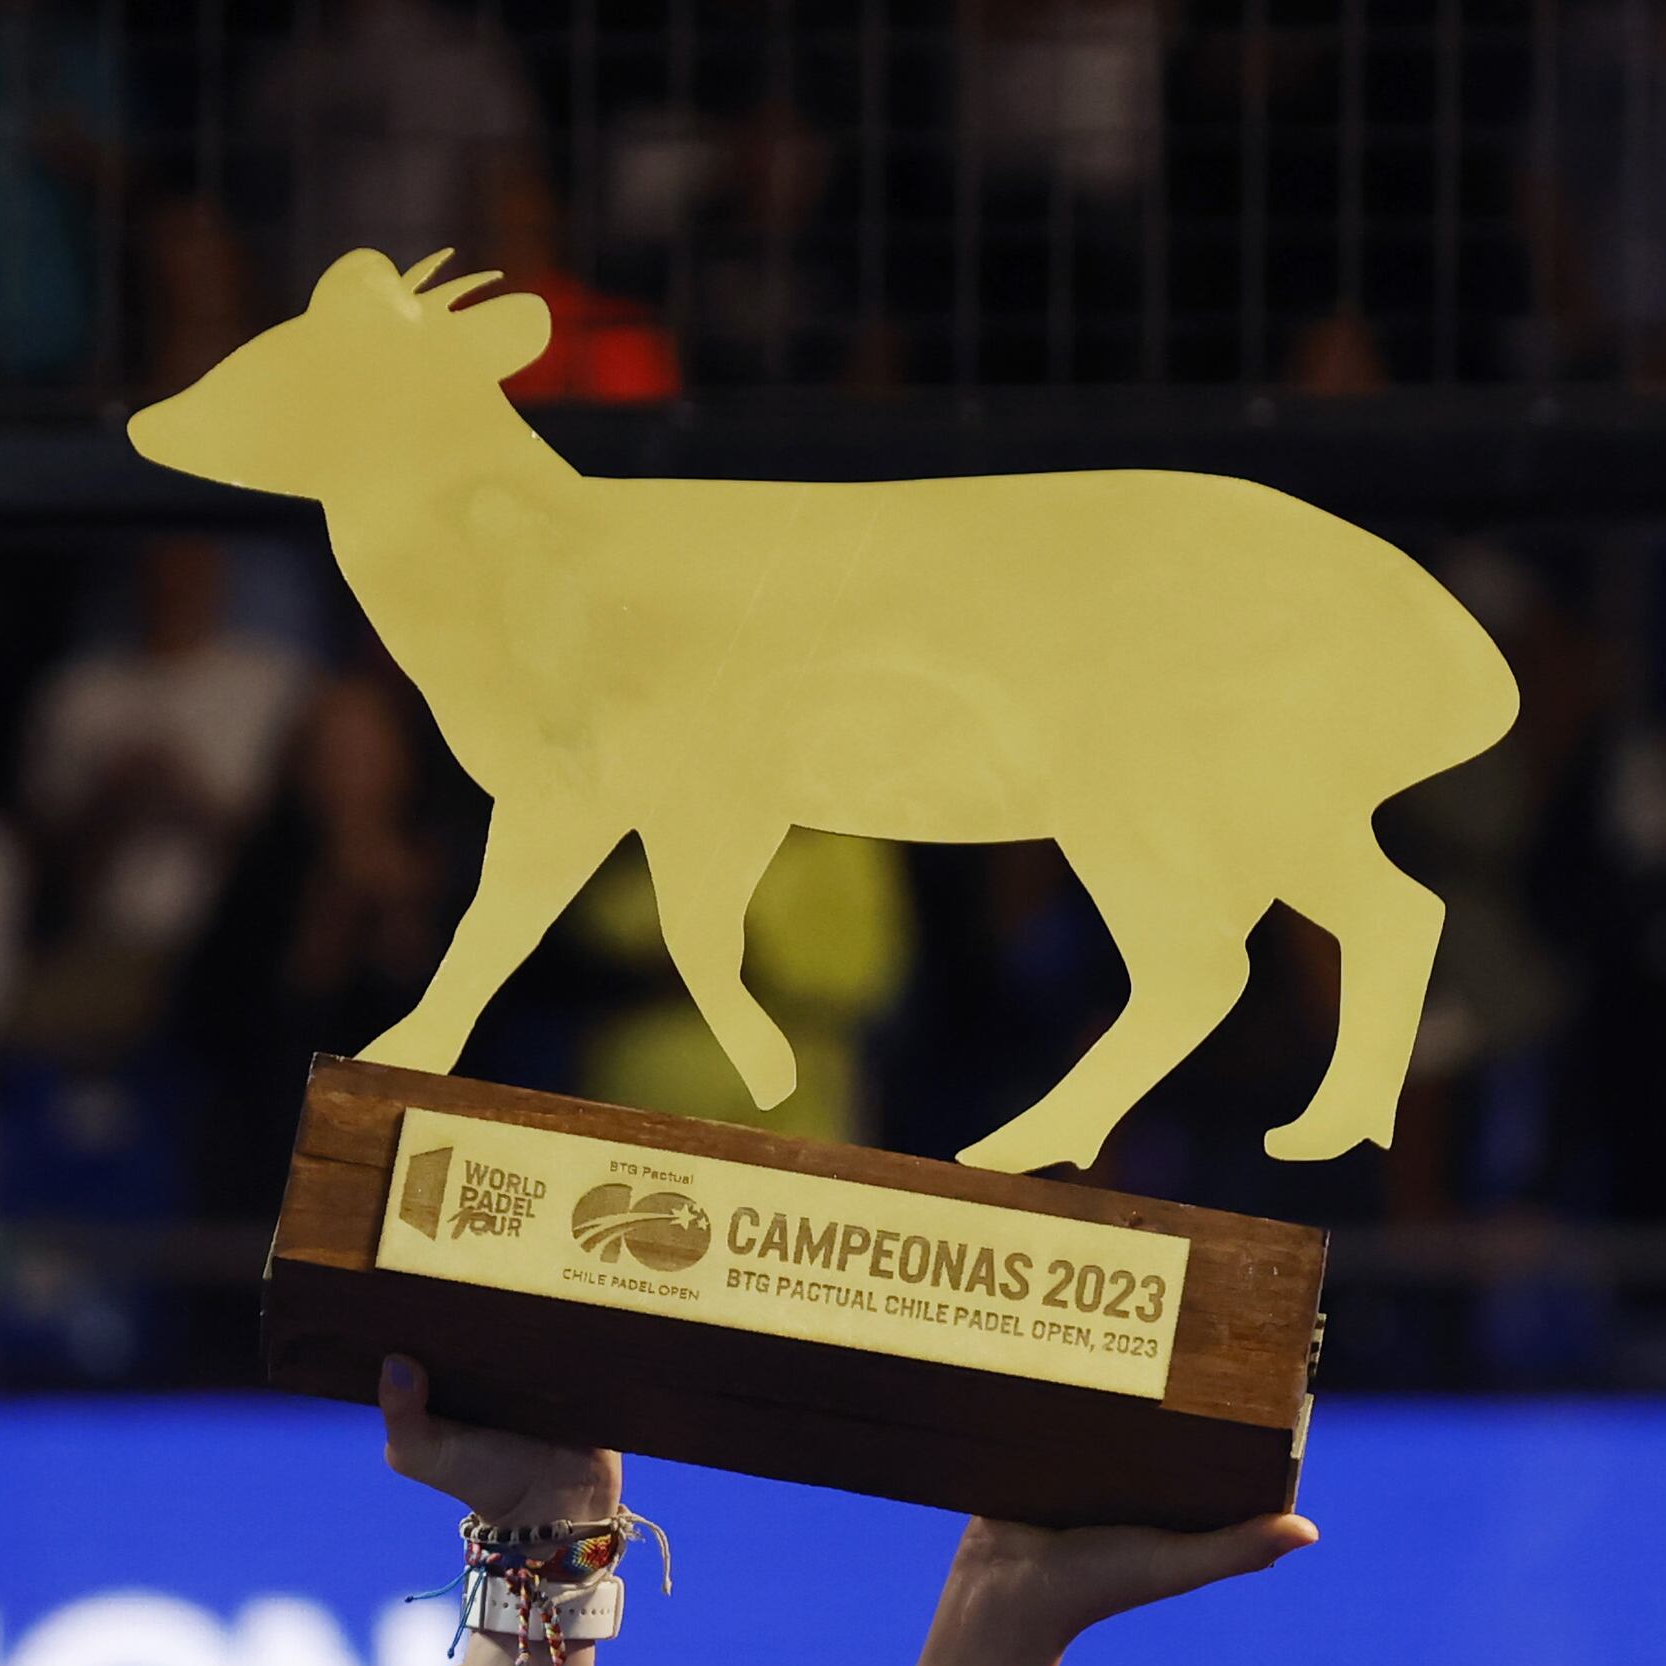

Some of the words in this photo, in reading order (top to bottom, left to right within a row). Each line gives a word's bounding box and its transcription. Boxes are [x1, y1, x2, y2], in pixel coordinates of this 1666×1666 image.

[464, 1160, 547, 1200] WORLD
[610, 1160, 638, 1176] BTG
[642, 1167, 694, 1185] Pactual
[459, 1186, 536, 1219] PADEL
[727, 1207, 1033, 1301] CAMPEONAS
[1041, 1259, 1166, 1323] 2023
[562, 1268, 606, 1286] CHILE
[611, 1276, 655, 1295] PADEL
[658, 1285, 700, 1301] OPEN
[726, 1268, 770, 1293] BTG
[776, 1277, 878, 1313] PACTUAL
[885, 1295, 950, 1324] CHILE
[953, 1306, 1025, 1337] PADEL
[1033, 1320, 1095, 1352] OPEN,
[1102, 1333, 1158, 1358] 2023
